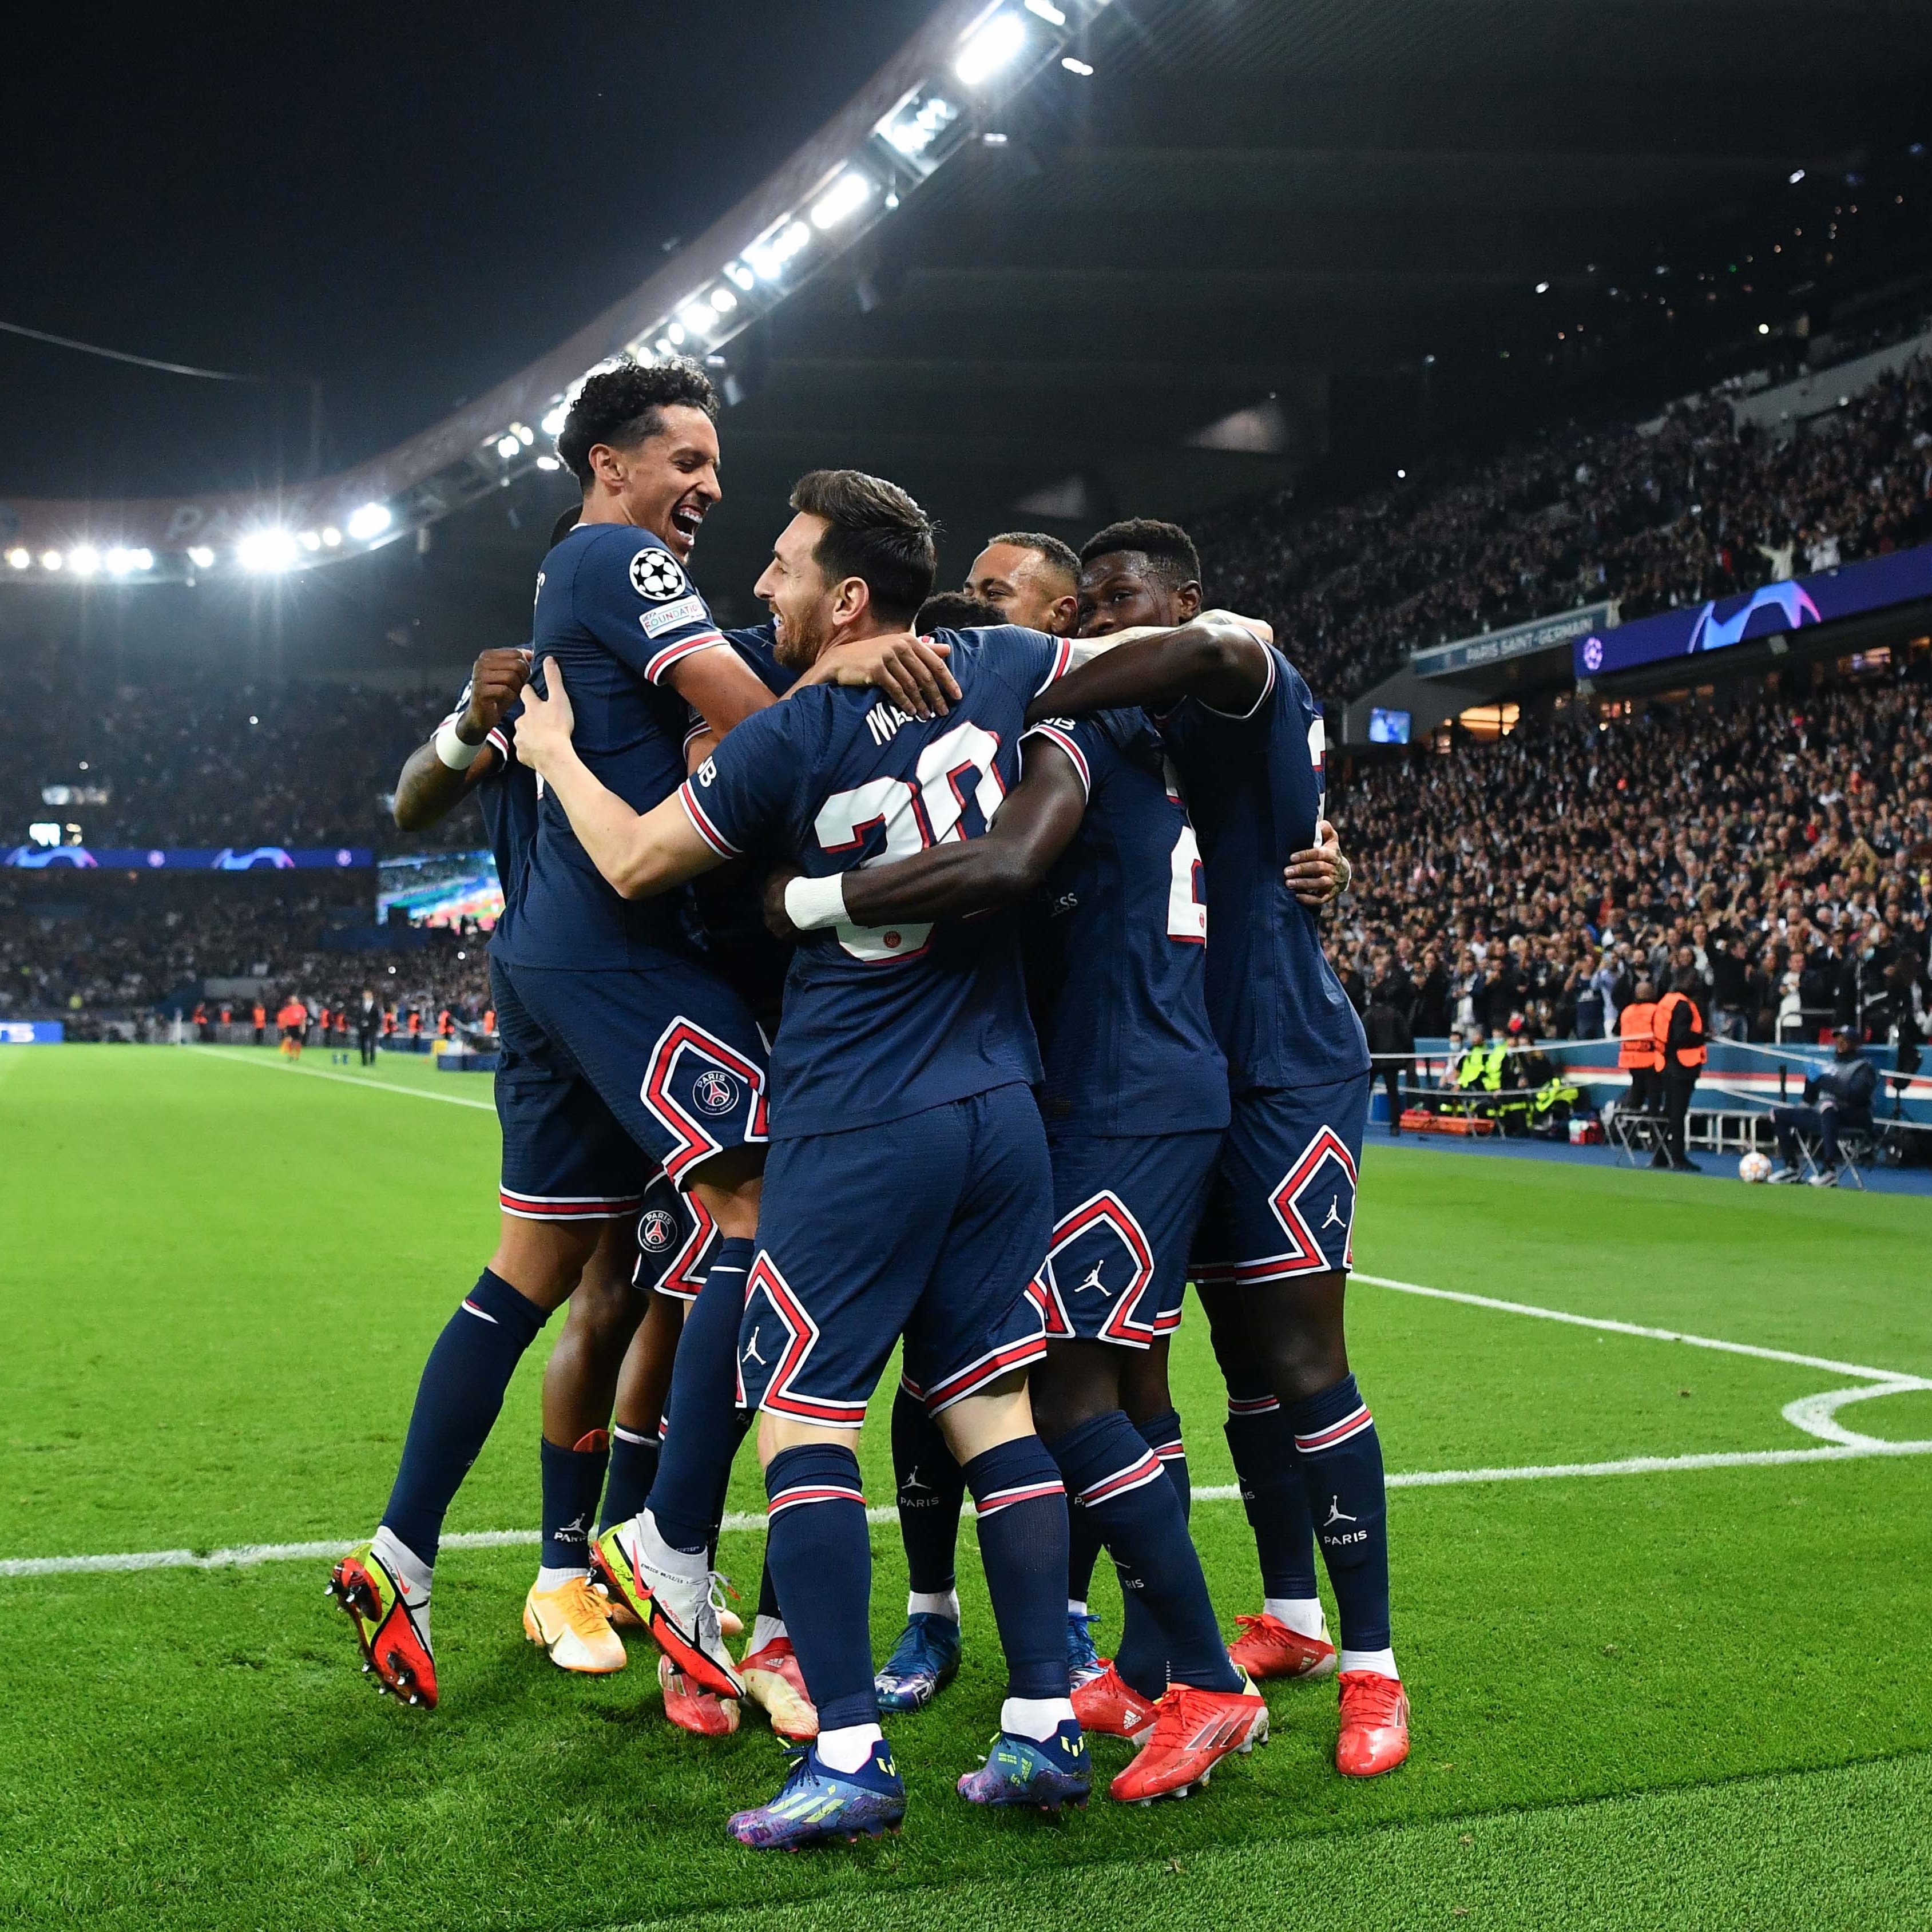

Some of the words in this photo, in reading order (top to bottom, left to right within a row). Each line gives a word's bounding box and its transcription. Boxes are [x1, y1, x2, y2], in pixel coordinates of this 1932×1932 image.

[644, 604, 700, 630] FOUNDATIO
[697, 1073, 725, 1088] PARIS
[646, 1212, 672, 1225] PARIS
[900, 1496, 939, 1507] PARIS
[1324, 1530, 1367, 1546] PARIS
